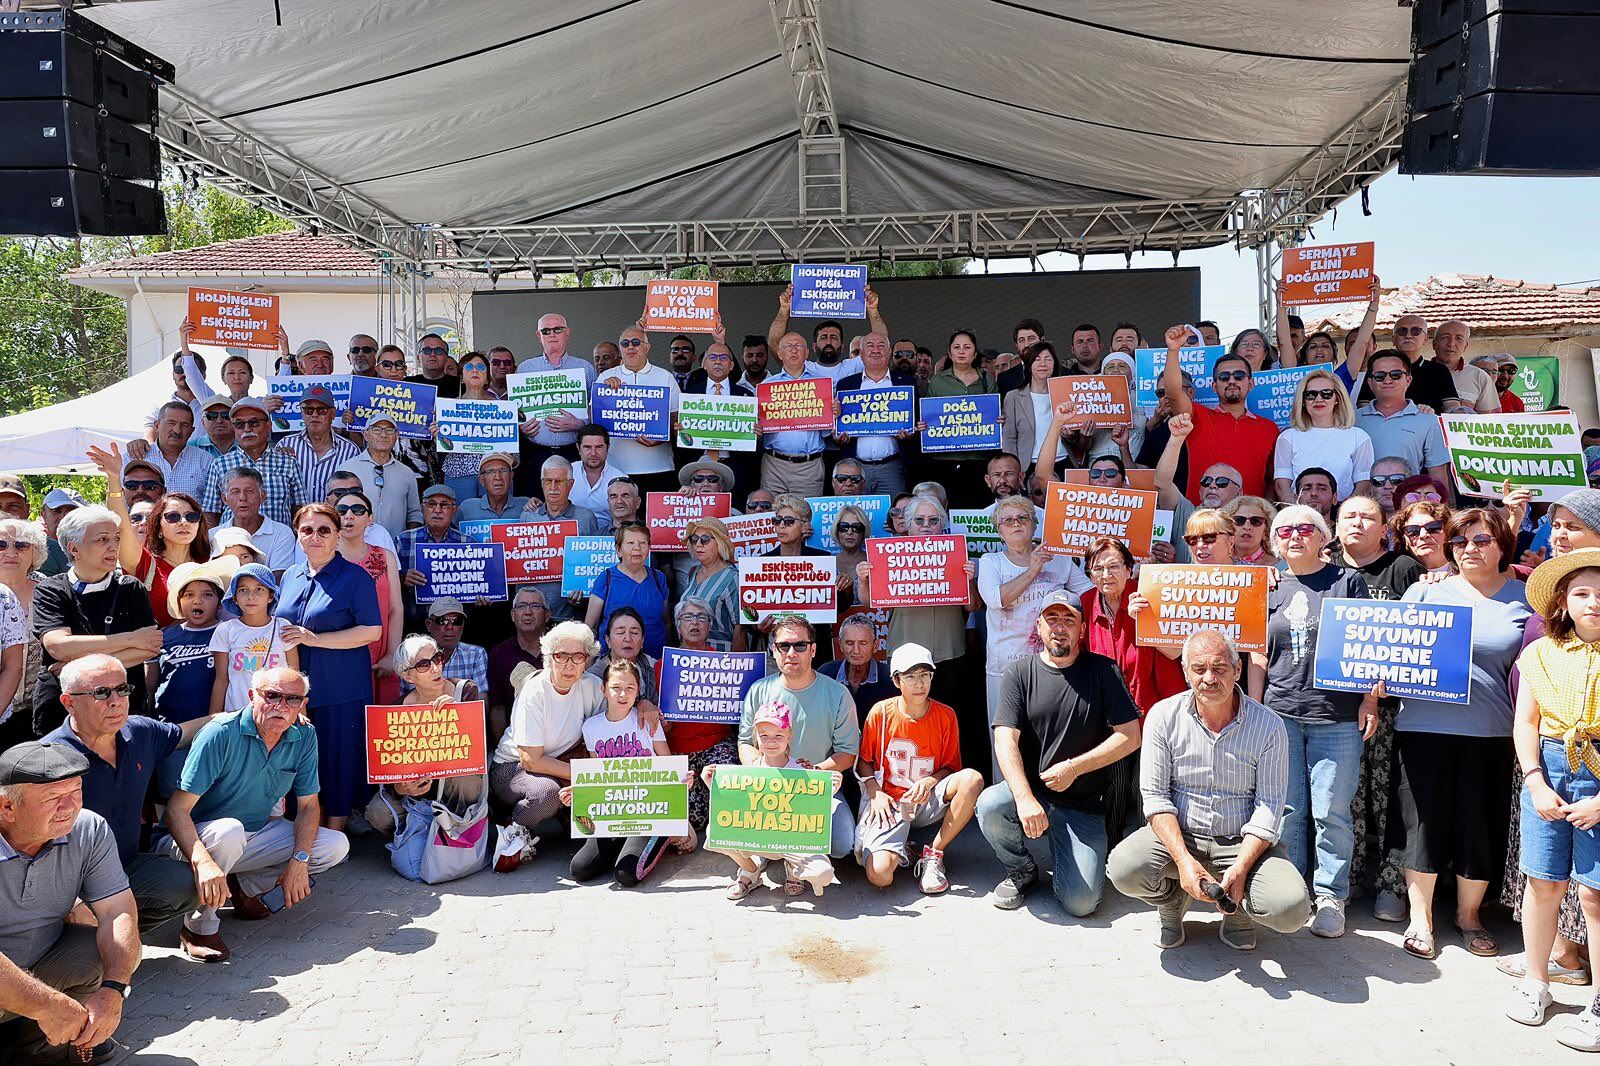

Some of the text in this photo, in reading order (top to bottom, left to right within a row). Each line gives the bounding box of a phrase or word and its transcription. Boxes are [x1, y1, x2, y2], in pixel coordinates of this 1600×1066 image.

[1299, 246, 1357, 260] SERMAYE
[1311, 257, 1342, 270] ELİNİ
[798, 267, 860, 278] HOLDİNGLERİ
[1286, 268, 1369, 283] DOĞAMIZDAN
[816, 278, 842, 288] DEĞİL
[1313, 282, 1340, 295] ÇEK!
[651, 286, 713, 296] ALPU OVASI
[195, 292, 273, 307] HOLDİNGLERİ
[668, 296, 696, 307] YOK
[813, 302, 843, 310] KORU!
[218, 305, 251, 317] DEĞİL
[649, 307, 714, 320] OLMASIN!
[216, 330, 253, 341] KORU!
[1153, 350, 1205, 363] ESNCE
[271, 380, 304, 393] DOĞA
[512, 379, 581, 393] MADEN ÇÖPLÜĞÜ
[526, 374, 567, 385] ESKİŞEHİR
[1072, 378, 1106, 391] DOĞA
[376, 384, 412, 398] DOĞA
[597, 386, 664, 398] HOLDİNGLERİ
[770, 382, 816, 393] HAVAMA
[771, 390, 815, 401] SUYUMA
[842, 392, 909, 404] ALPU OVASI
[370, 397, 416, 411] YAŞAM
[456, 402, 499, 412] ESKİŞEHİR
[616, 398, 644, 409] DEĞİL
[683, 399, 754, 415] DOĞA YAŞAM
[861, 400, 890, 412] YOK
[943, 399, 977, 413] DOĞA
[442, 410, 513, 421] MADEN ÇÖPLÜĞÜ
[766, 408, 823, 420] DOKUNMA!
[841, 411, 910, 424] OLMASIN!
[939, 413, 982, 427] YAŞAM
[440, 424, 514, 438] OLMASIN!
[614, 422, 646, 432] KORU!
[681, 417, 755, 433] ÖZGÜRLÜK!
[927, 424, 995, 438] ÖZGÜRLÜK!
[1448, 421, 1575, 436] HAVAMA SUYUMA
[1467, 432, 1553, 449] TOPRAĞIMA
[1459, 455, 1575, 477] DOKUNMA!
[663, 495, 716, 506] SERMAYE
[1057, 489, 1143, 509] TOPRAĞIMI
[673, 504, 702, 517] ELİNİ
[1065, 504, 1132, 522] SUYUMU
[506, 524, 561, 537] SERMAYE
[727, 518, 761, 530] ERMAYE
[1064, 519, 1127, 537] MADENE
[518, 535, 548, 548] ELİNİ
[876, 537, 954, 554] TOPRAĞIMI
[423, 545, 493, 559] TOPRAĞIMI
[504, 547, 564, 560] OĞAMIZDA
[431, 560, 486, 571] SUYUMU
[523, 560, 549, 573] ÇEK!
[762, 561, 814, 574] ESKİŞEHİR
[888, 554, 946, 567] SUYUMU
[431, 572, 484, 582] MADENE
[745, 570, 831, 584] MADEN ÇÖPLÜĞÜ
[889, 568, 945, 581] MADENE
[1151, 568, 1253, 587] TOPRAĞIMI
[431, 583, 489, 594] VERMEM!
[888, 582, 950, 596] VERMEM!
[1161, 587, 1239, 604] SUYUMU
[743, 588, 832, 604] OLMASIN!
[1160, 604, 1236, 621] MADENE
[1334, 604, 1454, 628] TOPRAĞIMI
[1345, 624, 1438, 647] SUYUMU
[1343, 643, 1433, 666] MADENE
[672, 654, 754, 670] TOPRAĞIMI
[680, 670, 744, 684] SUYUMU
[1339, 661, 1438, 687] VERMEM!
[679, 685, 740, 699] MADENE
[1323, 679, 1356, 689] ESKİŞEHİR
[1386, 685, 1412, 694] YAŞAM
[1413, 688, 1458, 699] PLATFORMU
[387, 709, 459, 725] HAVAMA
[388, 722, 459, 738] SUYUMA
[381, 747, 469, 765] DOKUNMA!
[375, 774, 402, 782] ESKİŞEHİR
[576, 771, 679, 784] ALANLARIMIZA
[720, 774, 826, 796] ALPU OVASI
[605, 786, 649, 801] SAHİP
[748, 793, 795, 813] YOK
[587, 802, 669, 819] ÇIKIYORUZ!
[717, 810, 824, 834] OLMASIN!
